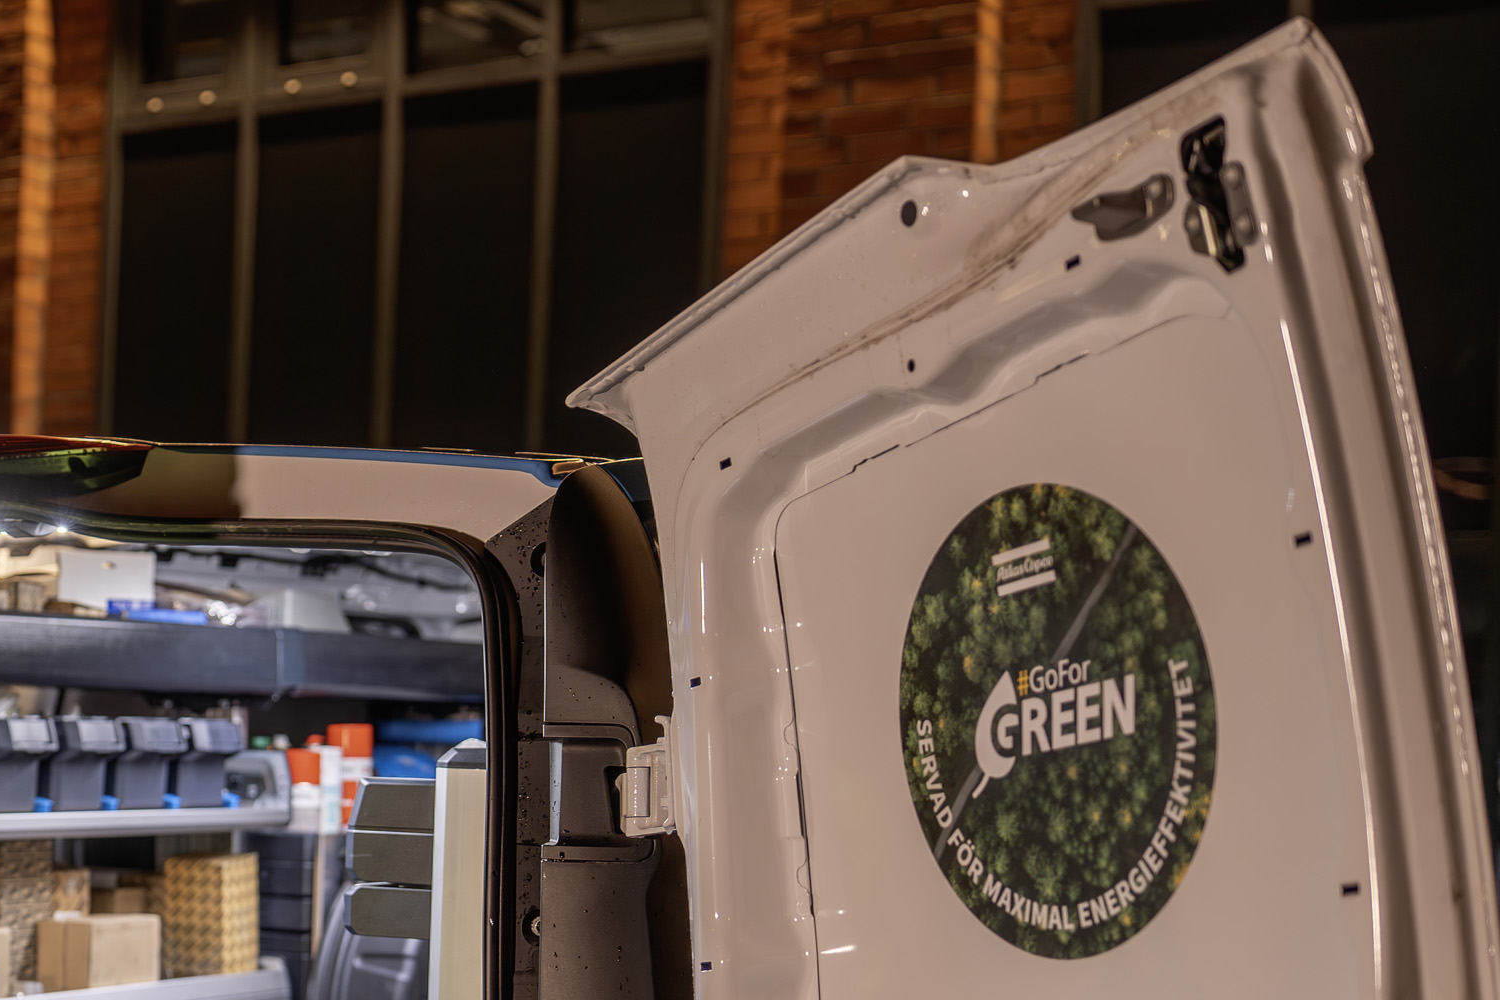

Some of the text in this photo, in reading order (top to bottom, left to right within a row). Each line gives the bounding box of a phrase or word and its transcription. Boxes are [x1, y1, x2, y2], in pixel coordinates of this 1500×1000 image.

[990, 673, 1136, 757] GREEN
[1017, 658, 1091, 697] #GoFor
[916, 658, 1197, 930] SERVAD FÖR MAXIMAL ENERGIEFFEKTIVITET
